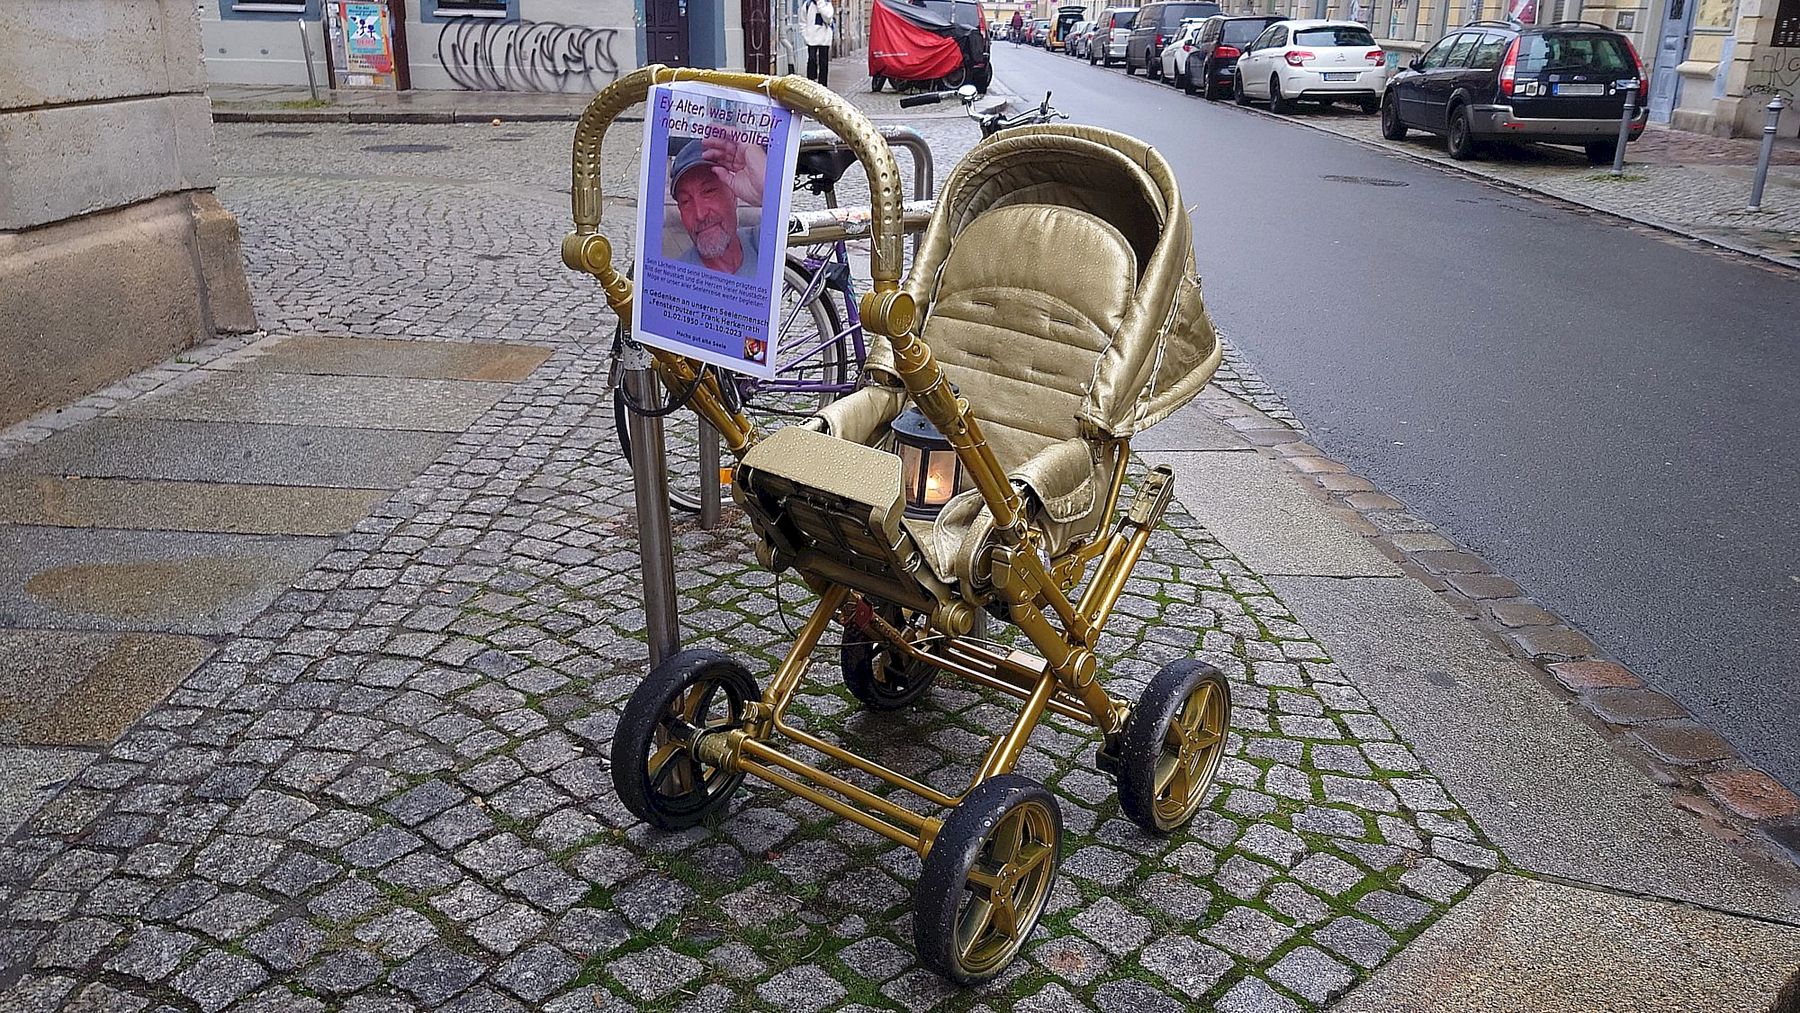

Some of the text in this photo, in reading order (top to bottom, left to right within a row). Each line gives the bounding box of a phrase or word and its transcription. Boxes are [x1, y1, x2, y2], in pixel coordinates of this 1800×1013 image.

[660, 96, 783, 129] Ey Alter, was ich Dir
[661, 117, 774, 148] noch sagen wollte:
[647, 257, 658, 265] Sein
[657, 260, 677, 270] Lächeln
[701, 271, 736, 286] Umarmungen
[736, 281, 757, 291] prägten
[663, 269, 685, 280] Neustadt
[704, 279, 723, 290] Herzen
[739, 288, 768, 301] Neustädter
[666, 278, 681, 286] unser
[650, 289, 681, 304] Gedenken
[691, 301, 719, 314] unseren
[719, 308, 769, 329] Seelenmensch
[663, 310, 699, 326] 01.02.1950
[704, 321, 742, 338] 01.10.2023
[701, 311, 720, 323] Frank
[721, 316, 760, 335] Herkenrath
[712, 340, 727, 350] Seele
